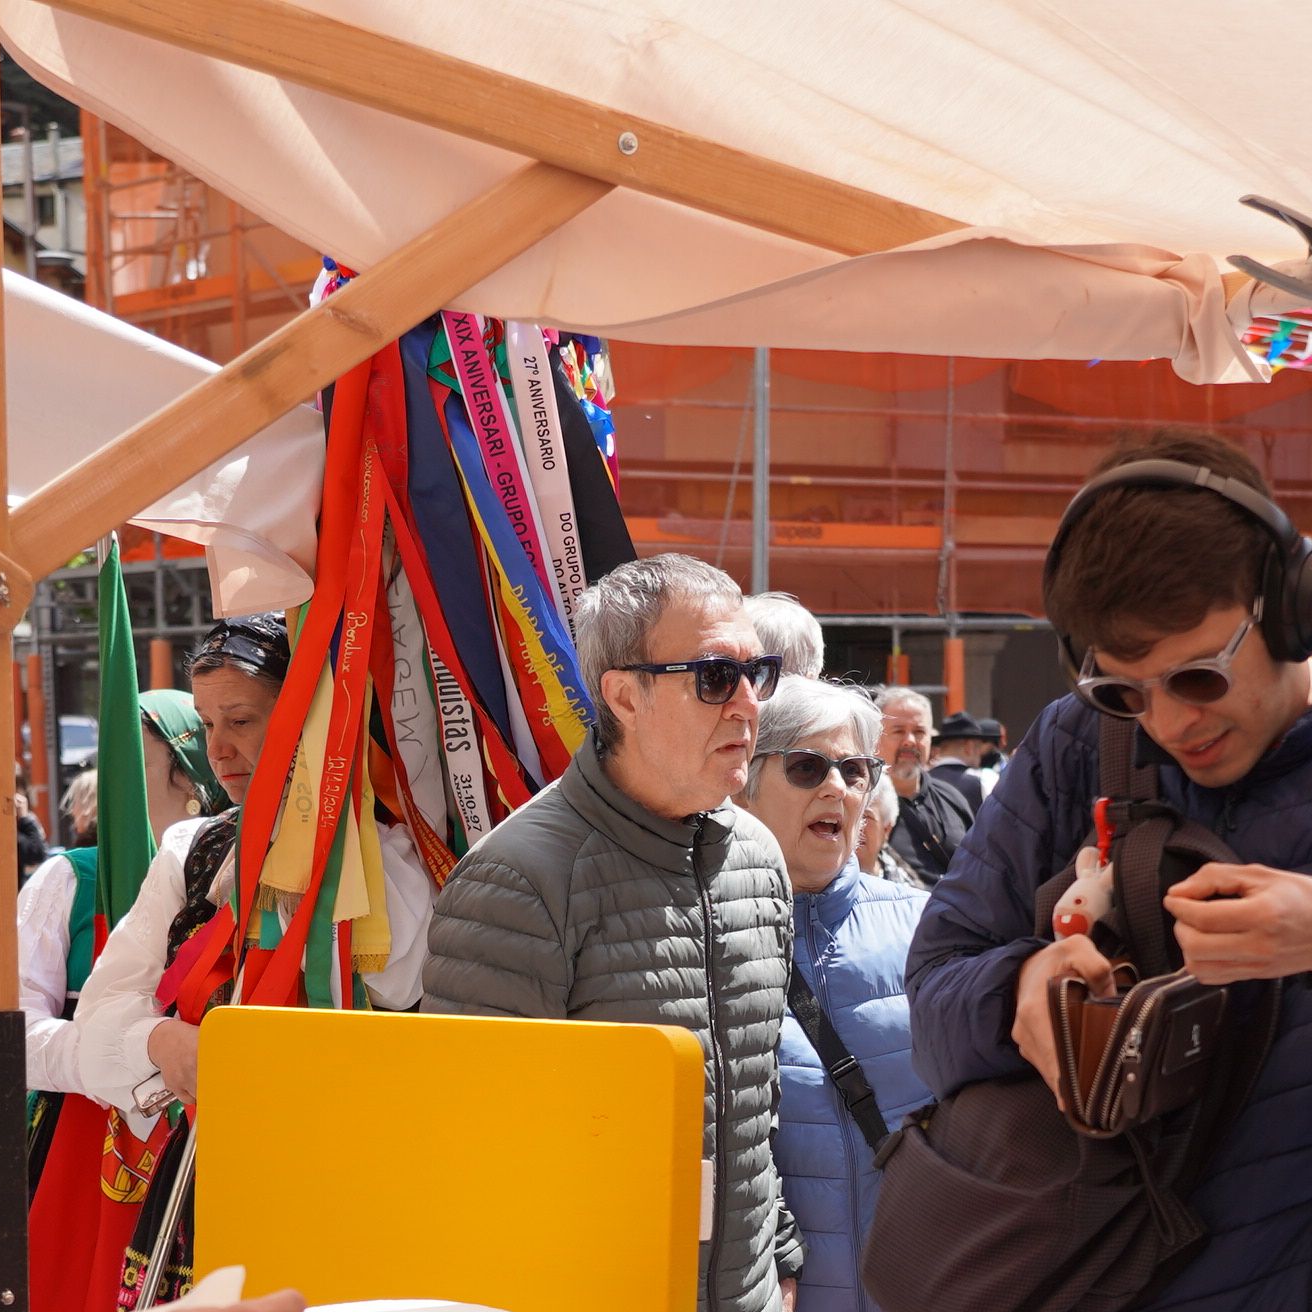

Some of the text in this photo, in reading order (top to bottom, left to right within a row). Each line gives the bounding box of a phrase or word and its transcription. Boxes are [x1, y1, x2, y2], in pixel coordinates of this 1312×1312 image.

[452, 316, 474, 347] XIX
[461, 350, 506, 458] ANIVERSARI
[528, 379, 556, 471] ANIVERSARIO
[496, 472, 528, 536] GRUPO
[559, 512, 573, 533] DO
[563, 536, 582, 584] GRUPO
[546, 652, 565, 677] DE
[537, 704, 556, 727] 98
[453, 773, 472, 832] ANDORRA
[460, 773, 483, 832] 31-10-97
